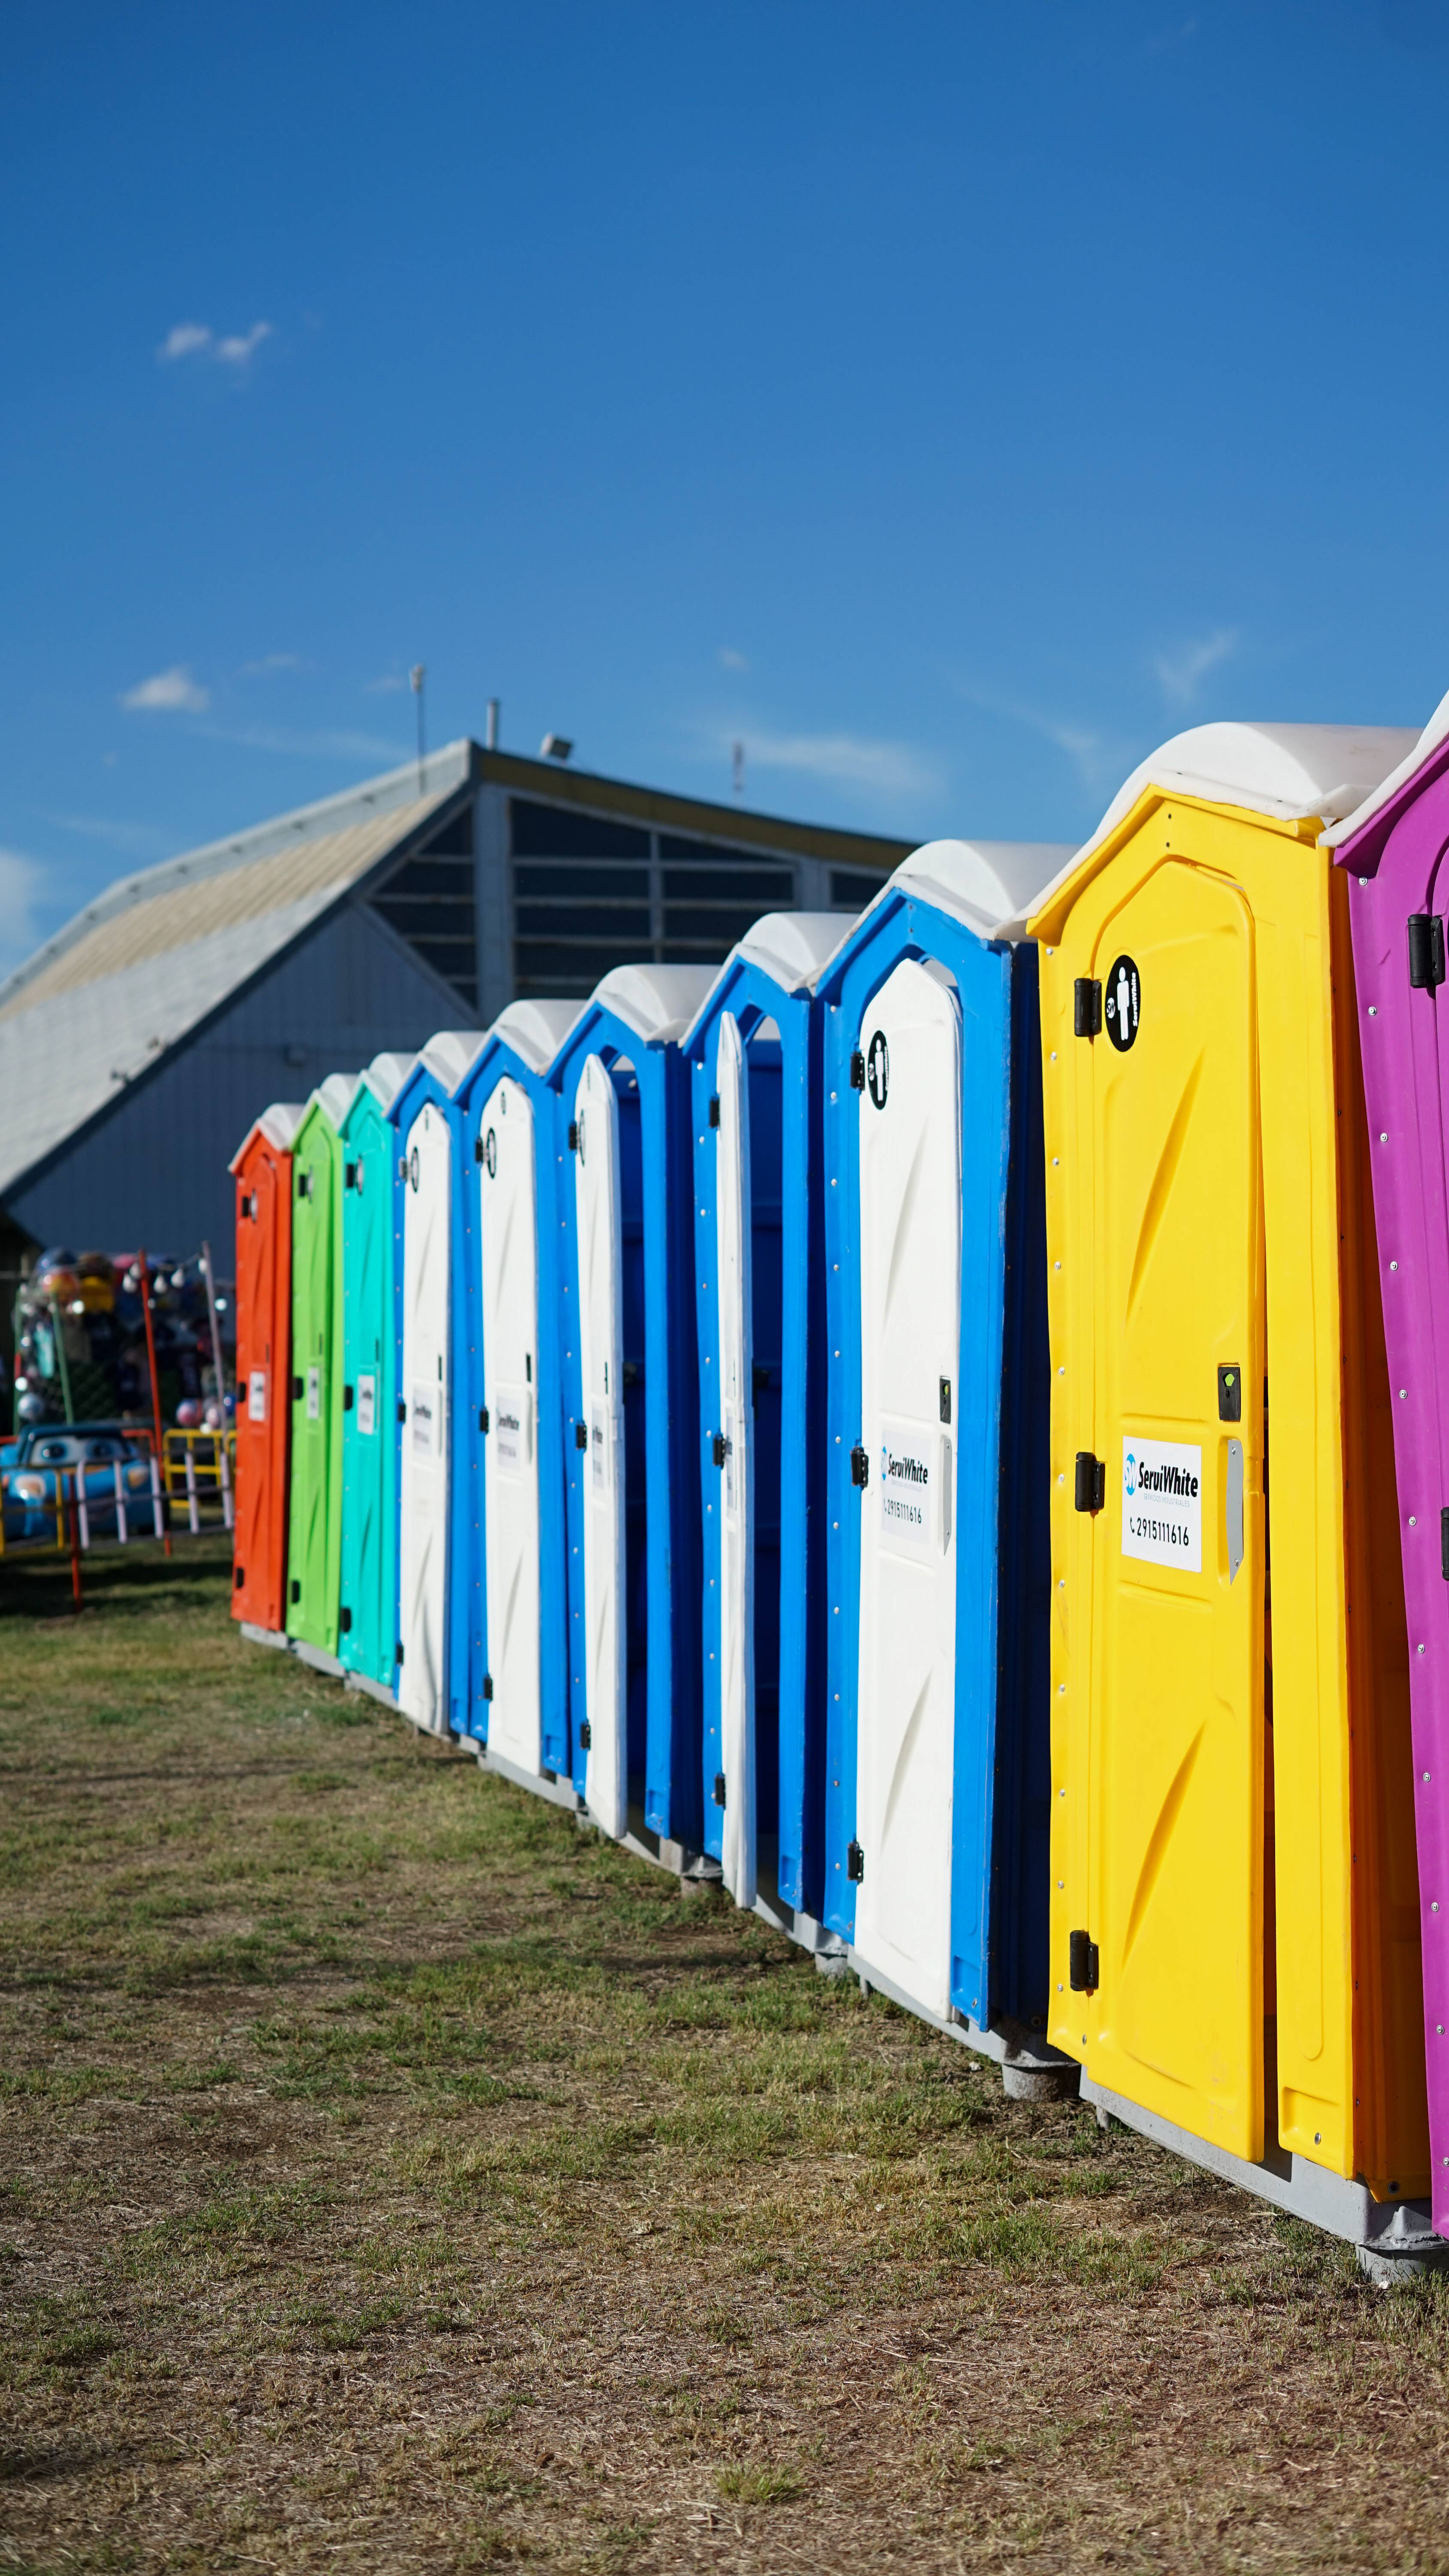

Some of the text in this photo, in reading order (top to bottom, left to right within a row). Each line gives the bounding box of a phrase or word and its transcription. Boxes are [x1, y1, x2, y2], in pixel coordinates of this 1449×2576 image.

[888, 1499, 922, 1524] 2915111616
[1144, 1493, 1190, 1507] SERVICIOS INDUSTRIALES
[1137, 1517, 1189, 1546] 2915111616
